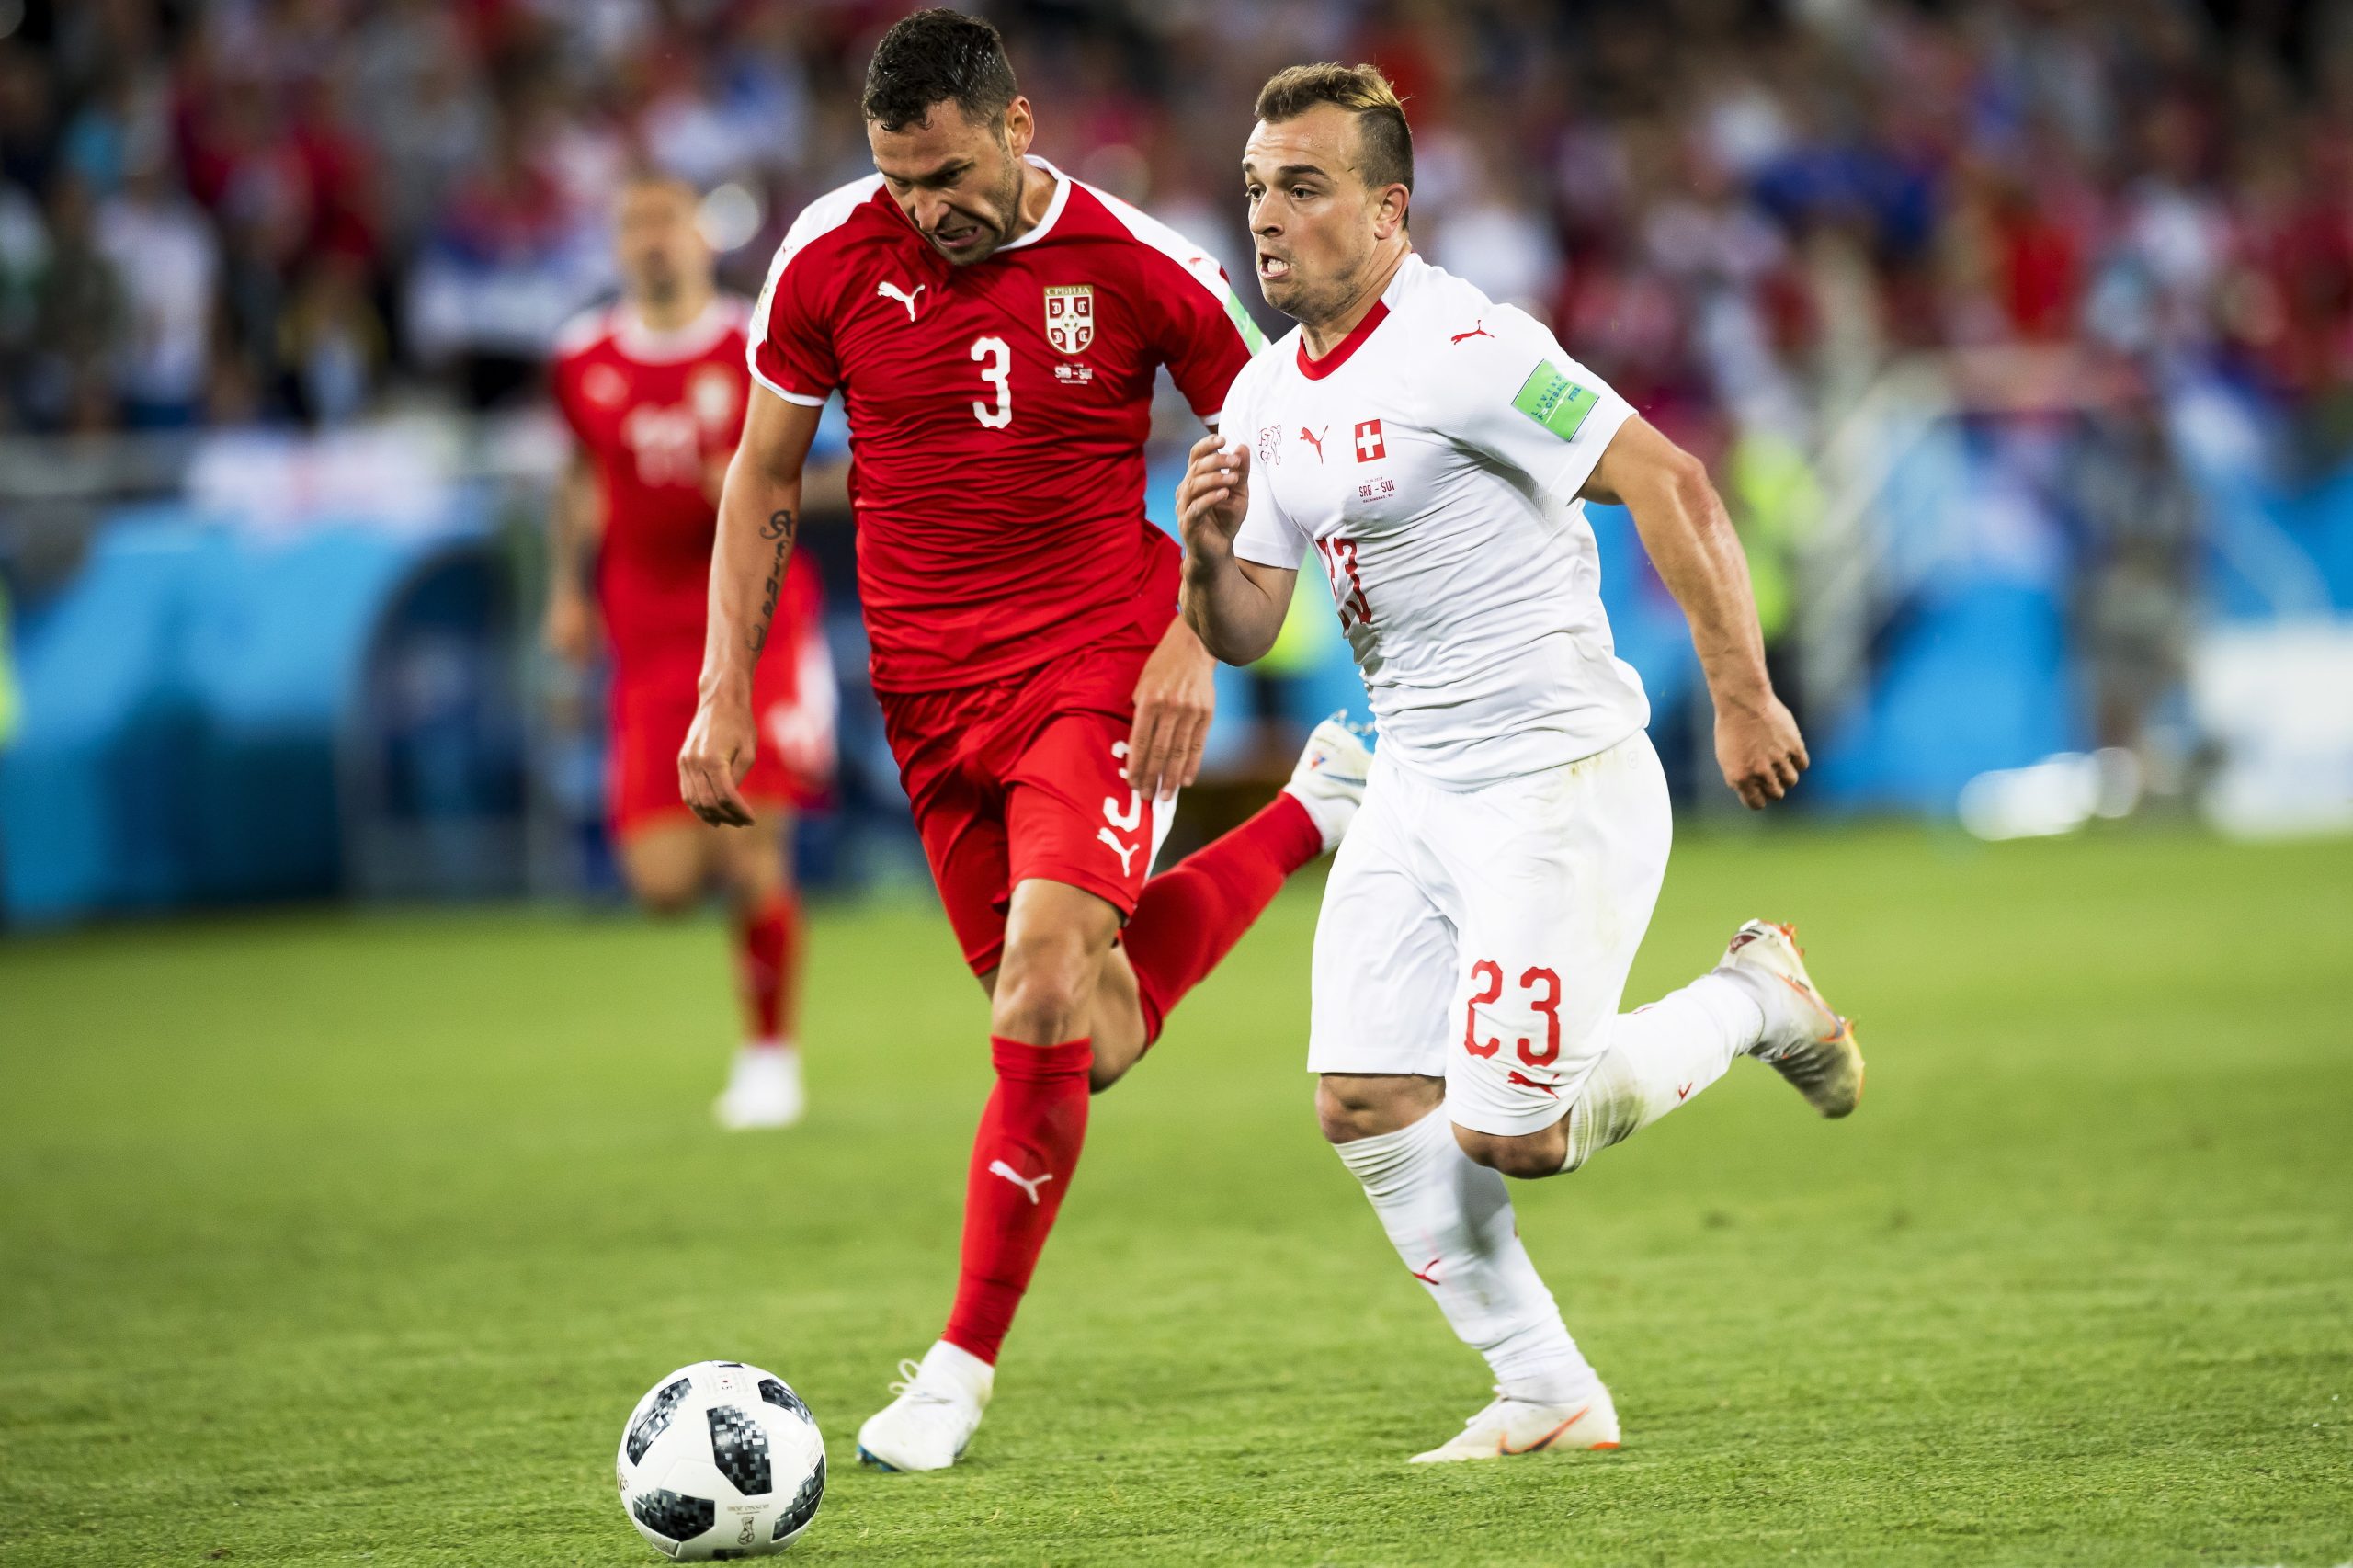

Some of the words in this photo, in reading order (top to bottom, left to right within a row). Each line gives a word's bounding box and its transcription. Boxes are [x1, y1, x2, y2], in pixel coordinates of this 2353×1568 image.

[971, 336, 1012, 429] 3
[1358, 484, 1372, 497] SRB
[1381, 480, 1395, 493] SUI
[1464, 959, 1561, 1067] 23
